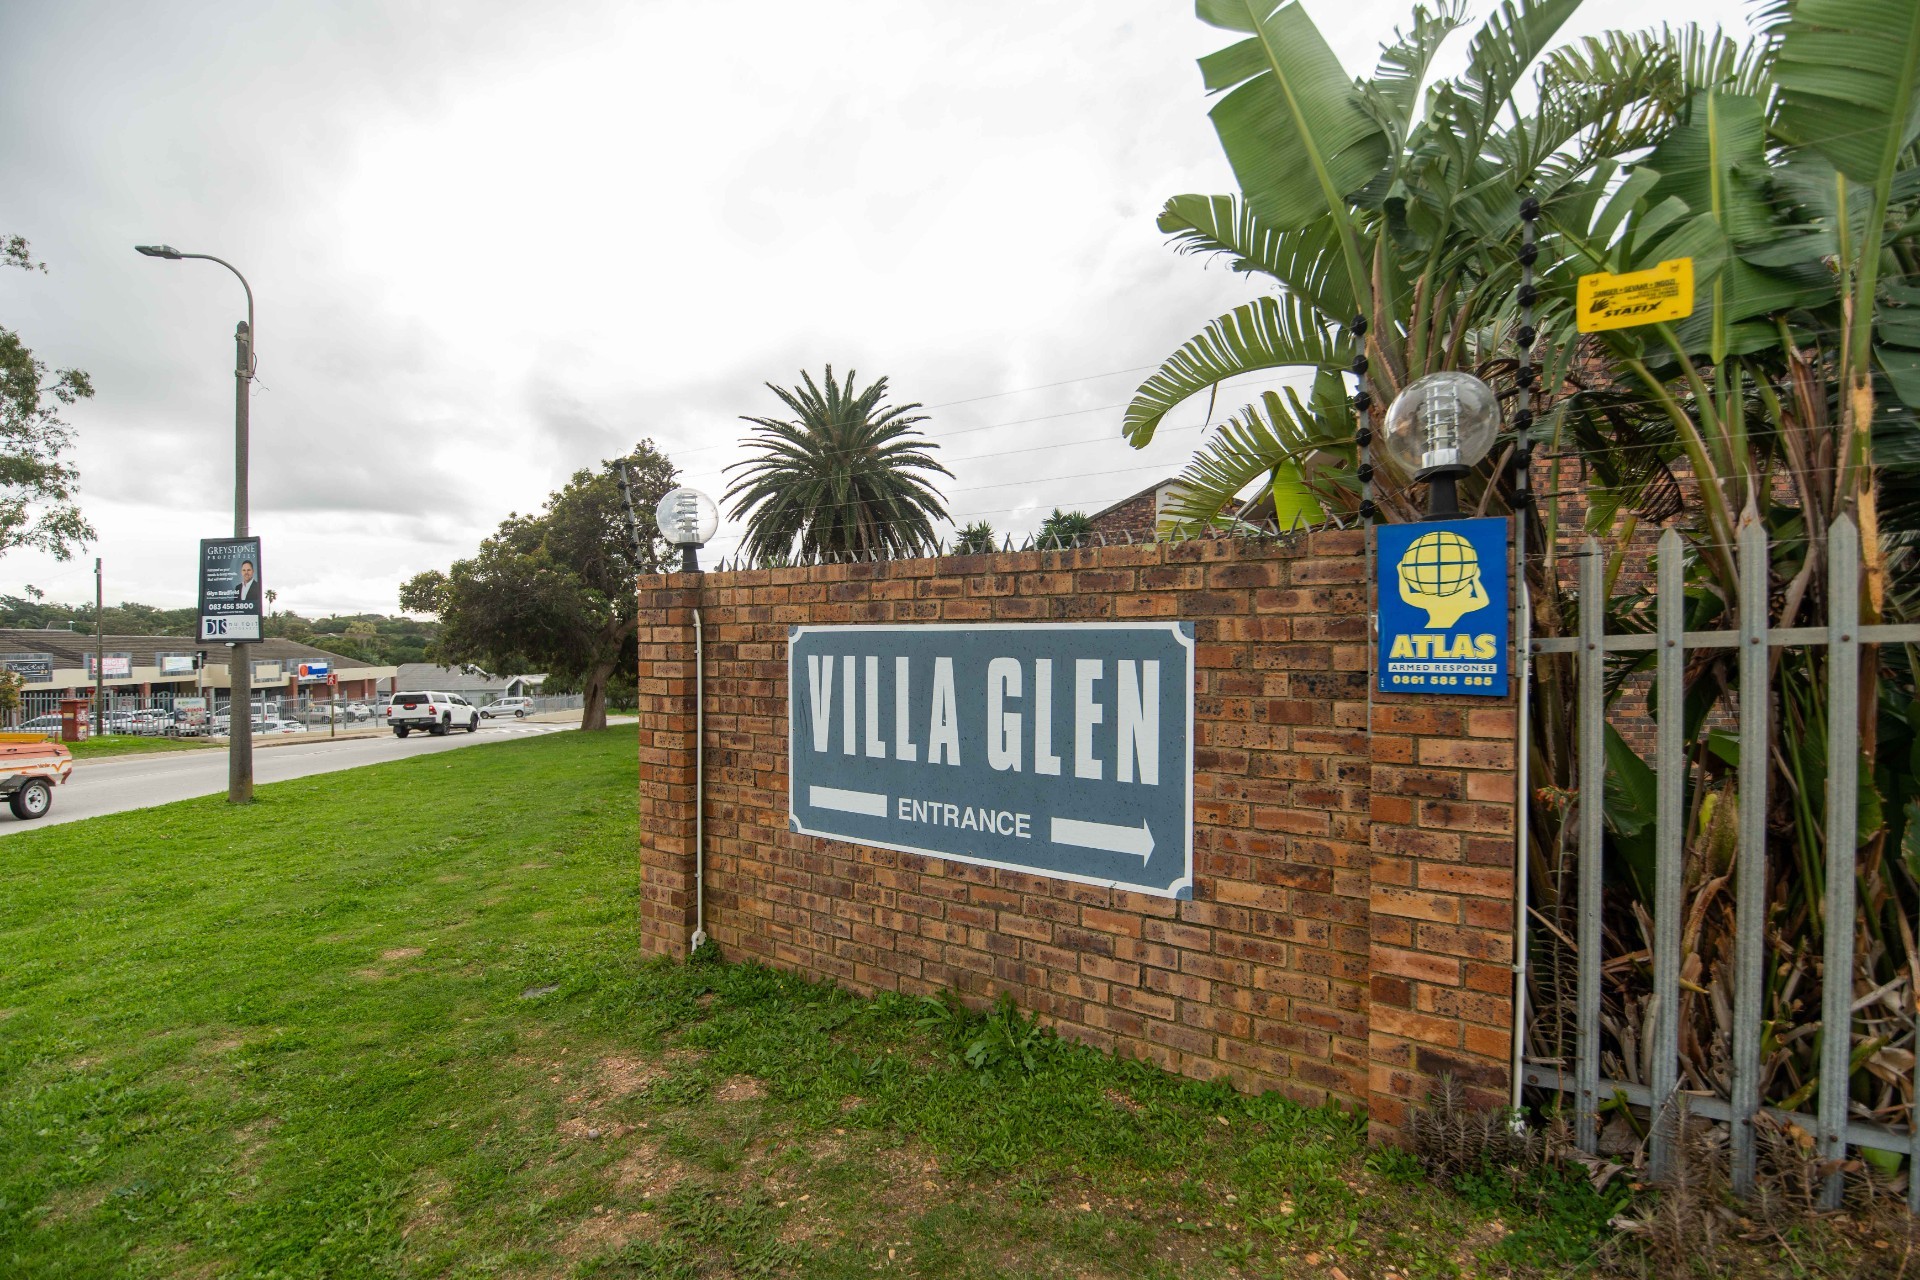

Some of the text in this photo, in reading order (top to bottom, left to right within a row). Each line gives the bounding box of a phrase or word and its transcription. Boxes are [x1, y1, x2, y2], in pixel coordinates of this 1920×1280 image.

[1603, 299, 1664, 318] STAFIX
[207, 545, 255, 554] GREYSTONE
[208, 603, 222, 611] 083
[1389, 633, 1497, 660] ATLAS
[1391, 663, 1494, 672] ARMED RESPONSE
[1392, 675, 1425, 685] 0861
[1430, 675, 1458, 686] 585
[1464, 676, 1493, 687] 585
[808, 655, 1160, 786] VILLA GLEN
[898, 798, 1032, 839] ENTRANCE
